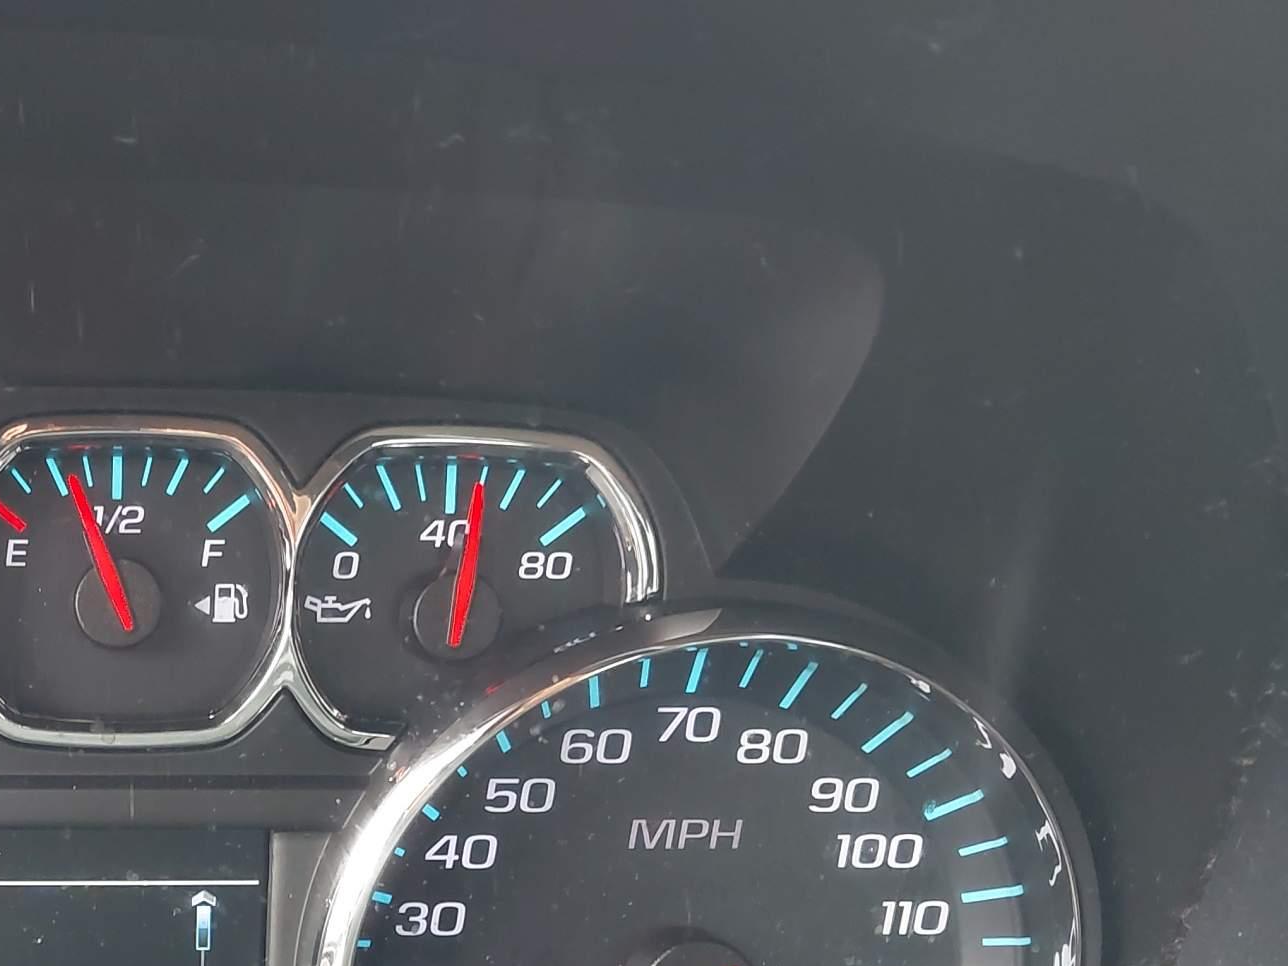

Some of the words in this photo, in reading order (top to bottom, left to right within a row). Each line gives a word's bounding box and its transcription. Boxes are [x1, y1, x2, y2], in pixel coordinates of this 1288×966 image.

[93, 505, 145, 534] 1/2
[420, 519, 470, 548] 40
[5, 539, 29, 567] E
[201, 539, 226, 567] F
[332, 551, 360, 580] 0
[518, 551, 573, 580] 80
[657, 706, 721, 743] 70
[560, 728, 633, 765] 60
[736, 728, 809, 765] 80
[484, 778, 556, 813] 50
[808, 777, 880, 813] 90
[424, 834, 498, 869] 40
[628, 819, 743, 850] MPH
[837, 833, 924, 869] 100
[395, 901, 466, 936] 30
[882, 900, 950, 935] 110
